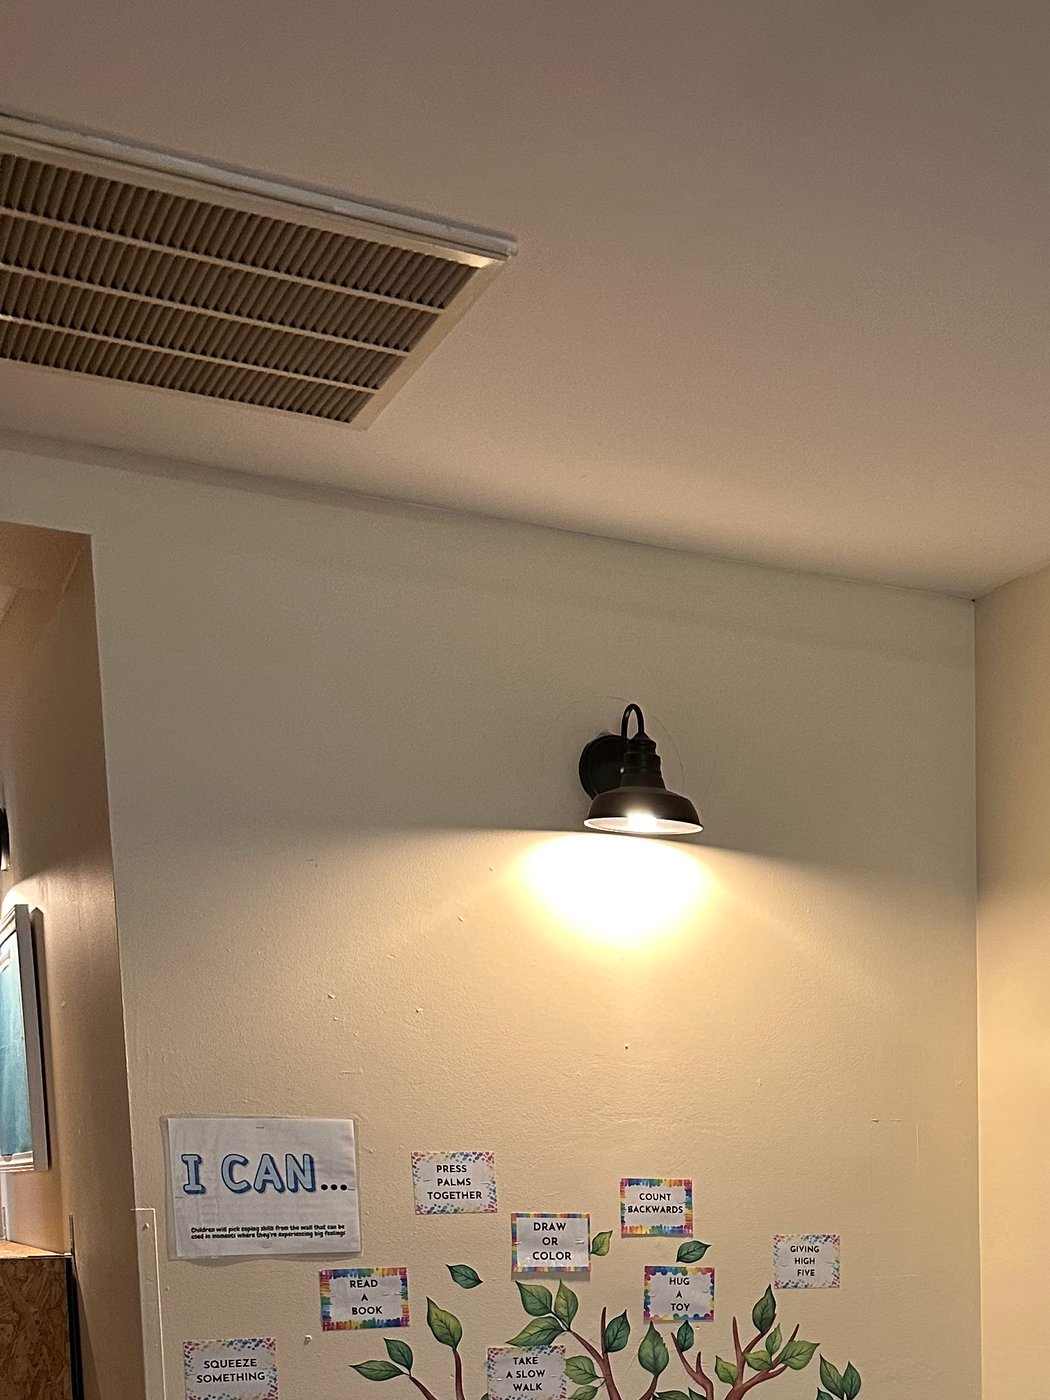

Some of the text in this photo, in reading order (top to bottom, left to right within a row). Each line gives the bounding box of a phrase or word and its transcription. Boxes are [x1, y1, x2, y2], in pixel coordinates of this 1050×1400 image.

[181, 1154, 348, 1193] I CAN...
[436, 1165, 467, 1174] PRESS
[437, 1178, 471, 1187] PALMS
[427, 1191, 483, 1200] TOGETHER
[639, 1193, 671, 1201] COUNT
[627, 1205, 684, 1214] BACKWARDS
[533, 1222, 567, 1232] DRAW
[542, 1237, 558, 1246] OR
[790, 1245, 820, 1254] GIVING
[532, 1251, 572, 1261] COLOR
[794, 1257, 816, 1266] HIGH
[797, 1269, 816, 1277] FIVE
[350, 1279, 378, 1289] READ
[669, 1277, 690, 1286] HUG
[361, 1294, 368, 1302] A
[676, 1291, 683, 1299] A
[352, 1306, 383, 1315] BOOK
[670, 1303, 690, 1311] TOY
[203, 1358, 258, 1369] SQUEEZE
[512, 1356, 539, 1366] TAKE
[196, 1371, 266, 1383] SOMETHING
[505, 1369, 546, 1379] A SLOW
[512, 1383, 543, 1392] WALK
